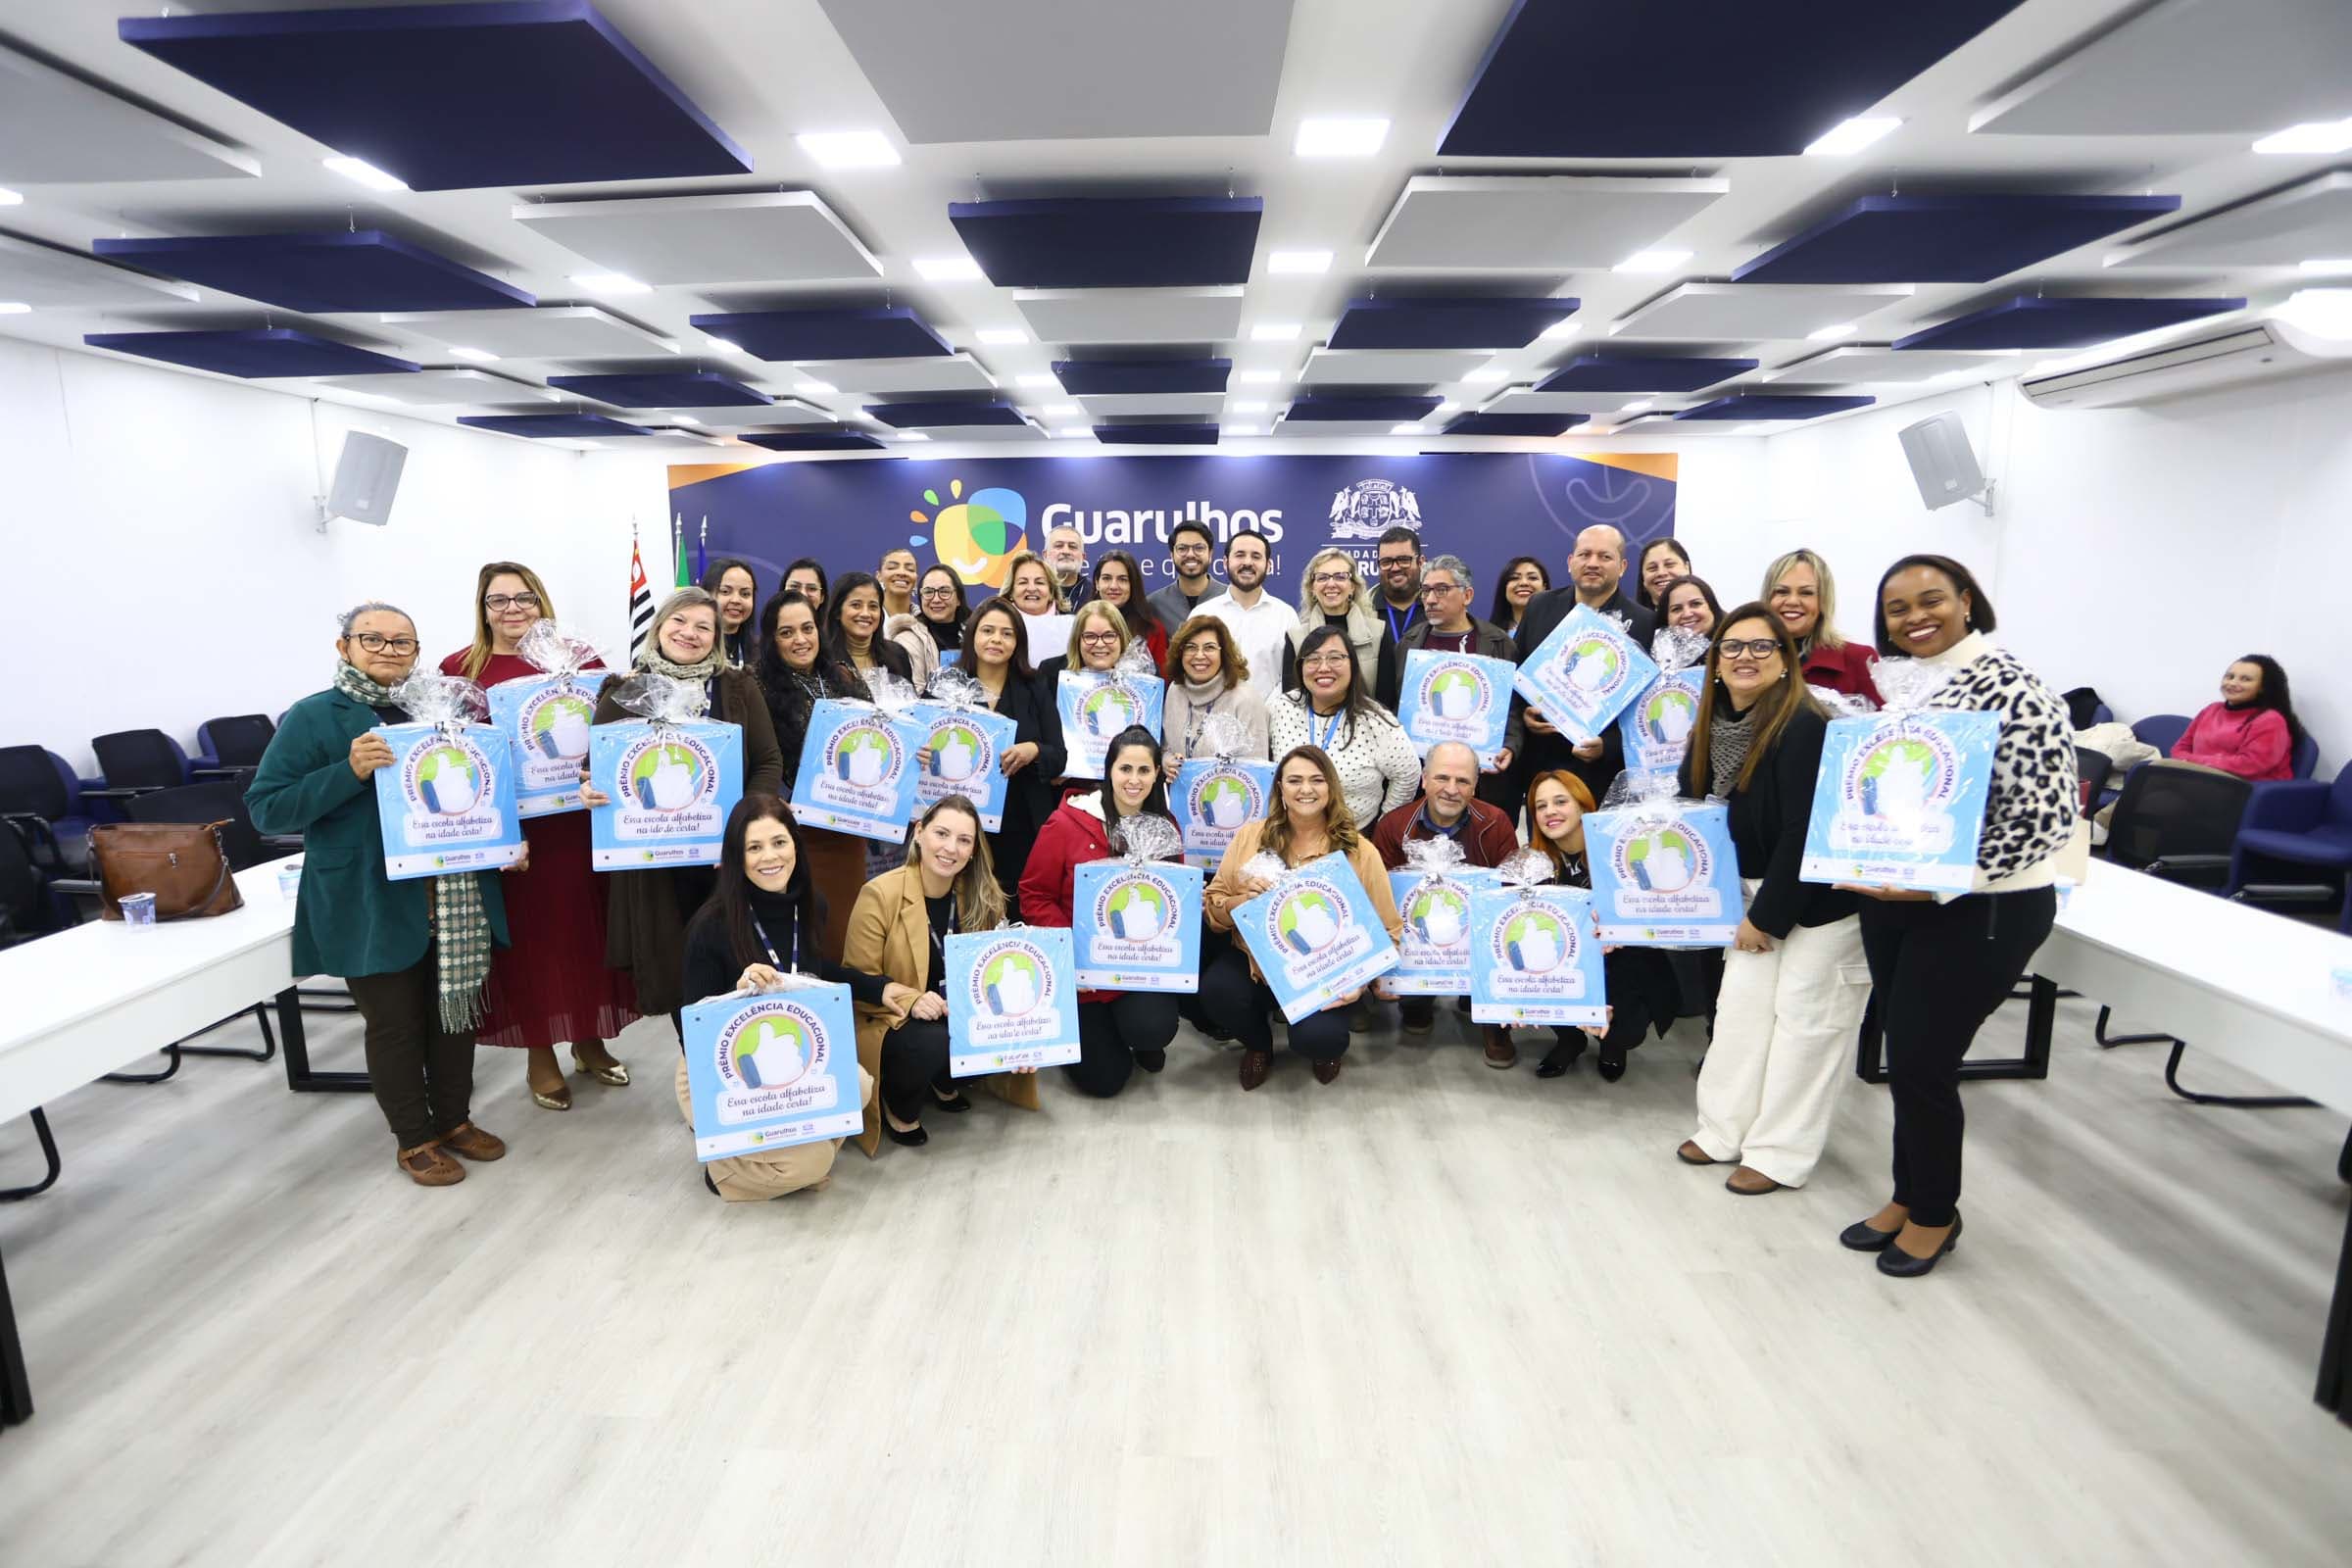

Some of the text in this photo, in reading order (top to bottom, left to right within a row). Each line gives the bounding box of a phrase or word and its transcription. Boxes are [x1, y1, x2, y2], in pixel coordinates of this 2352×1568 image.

[1042, 502, 1283, 543] Guarulhos
[827, 735, 839, 765] PRÊMIO
[884, 727, 901, 779] EDUCACIONAL
[619, 761, 631, 798] PRÊMIO
[671, 812, 712, 824] alfabetiza
[1152, 877, 1178, 929] EDUCACIONAL
[1305, 880, 1348, 919] EDUCACIONAL
[971, 969, 983, 1004] PRÊMIO
[1023, 944, 1052, 997] EDUCACIONAL
[718, 1003, 825, 1079] PRÊMIO EXCELÊNCIA EDUCACIONAL
[727, 1084, 825, 1107] Essa escola alfabetiza
[758, 1102, 784, 1114] idade
[787, 1096, 812, 1109] certa!
[764, 1127, 797, 1138] Guarulhos
